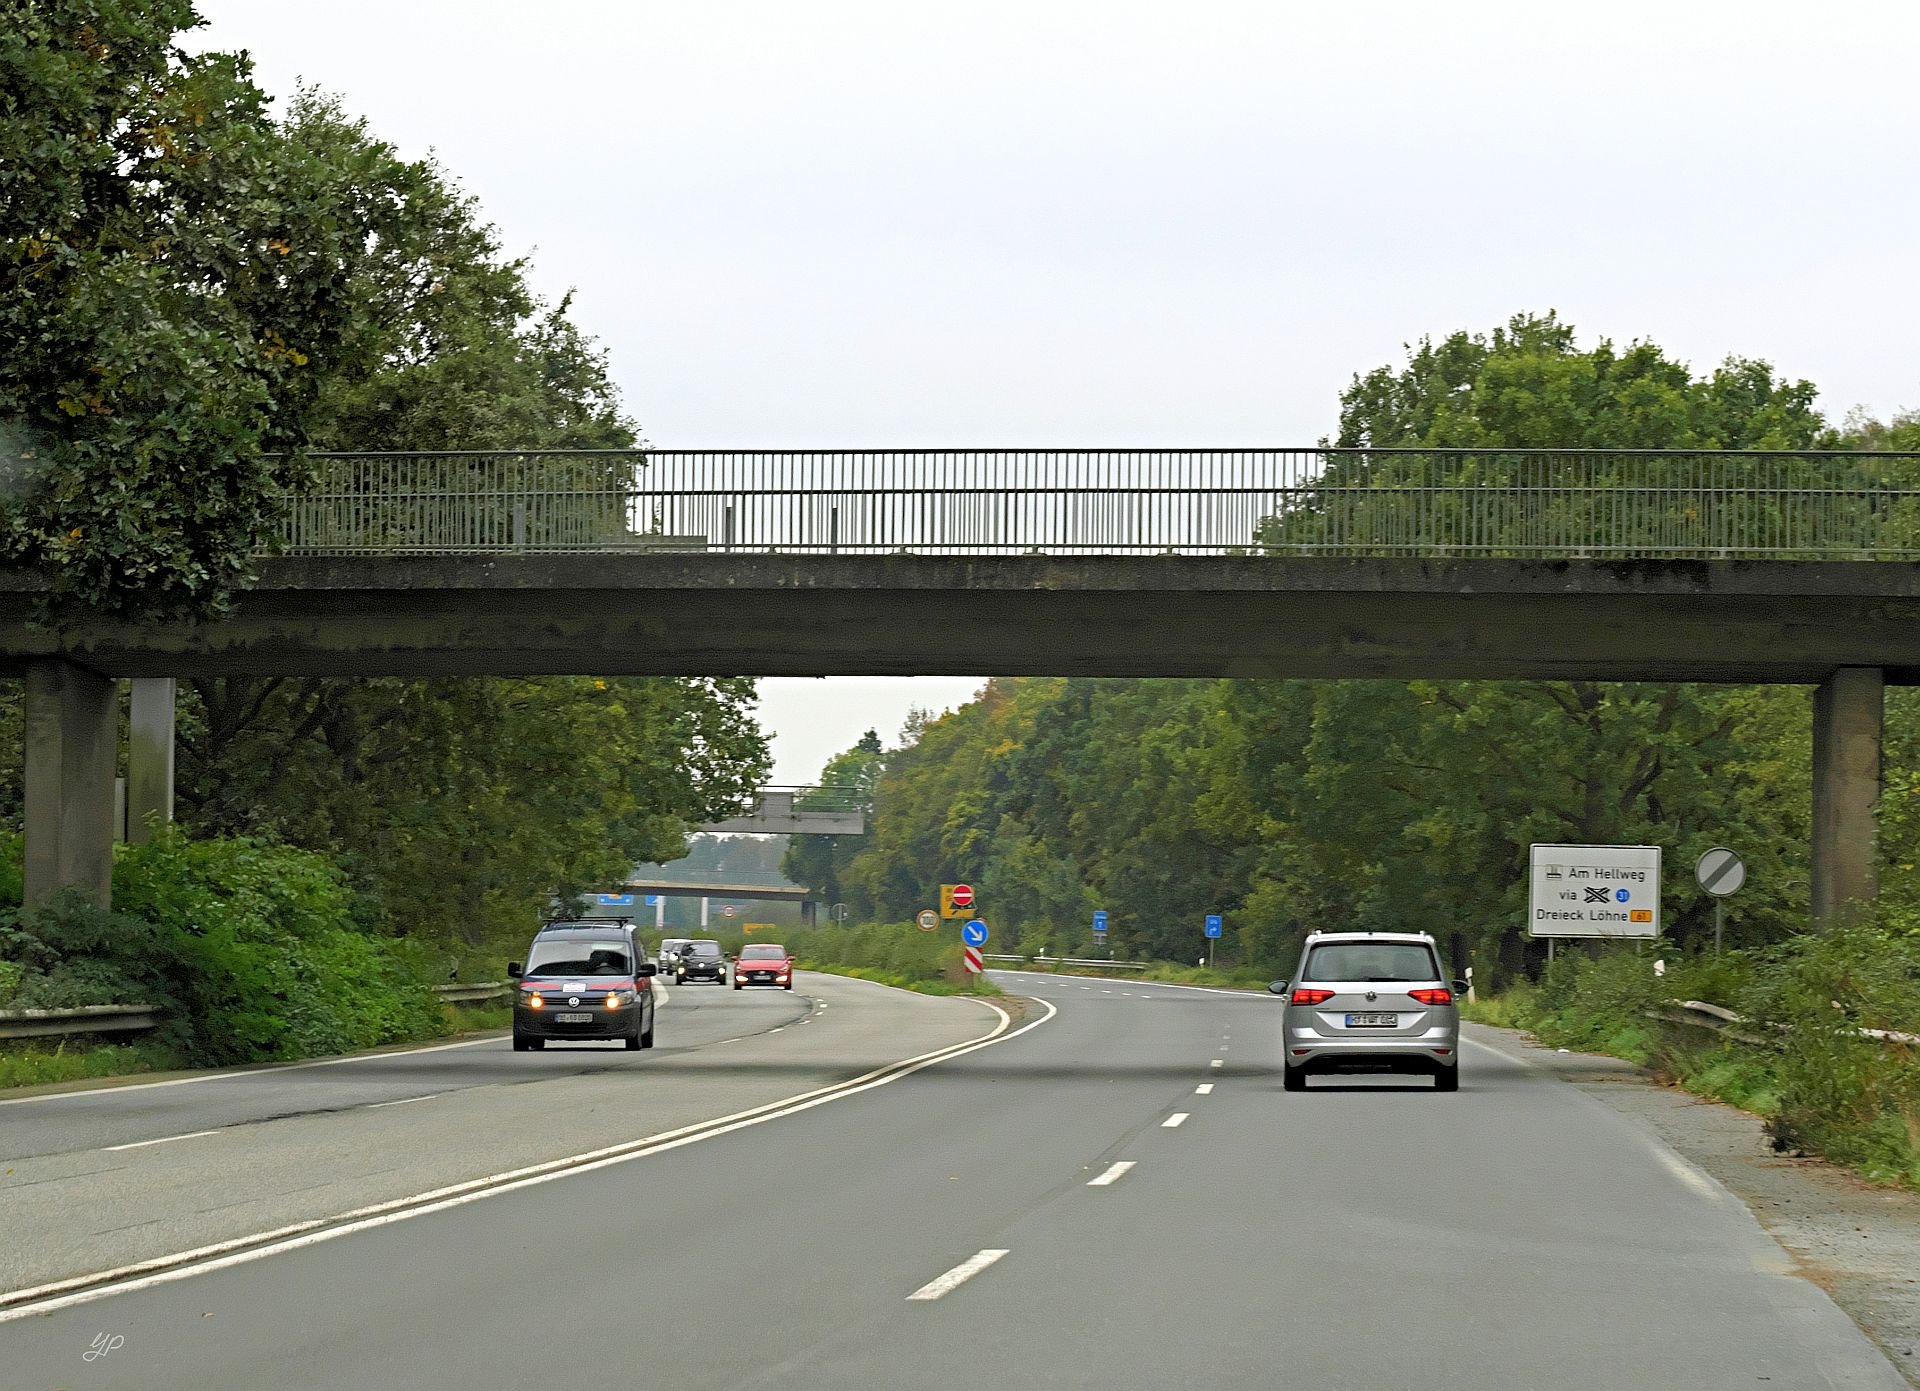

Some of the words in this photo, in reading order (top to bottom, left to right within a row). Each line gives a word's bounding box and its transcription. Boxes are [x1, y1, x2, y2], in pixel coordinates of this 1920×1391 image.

[1568, 868, 1590, 879] Am
[1594, 868, 1645, 882] Hellweg
[1559, 889, 1578, 901] via
[1618, 891, 1629, 901] 31
[1537, 909, 1584, 920] Dreieck
[1590, 910, 1628, 921] Löhne
